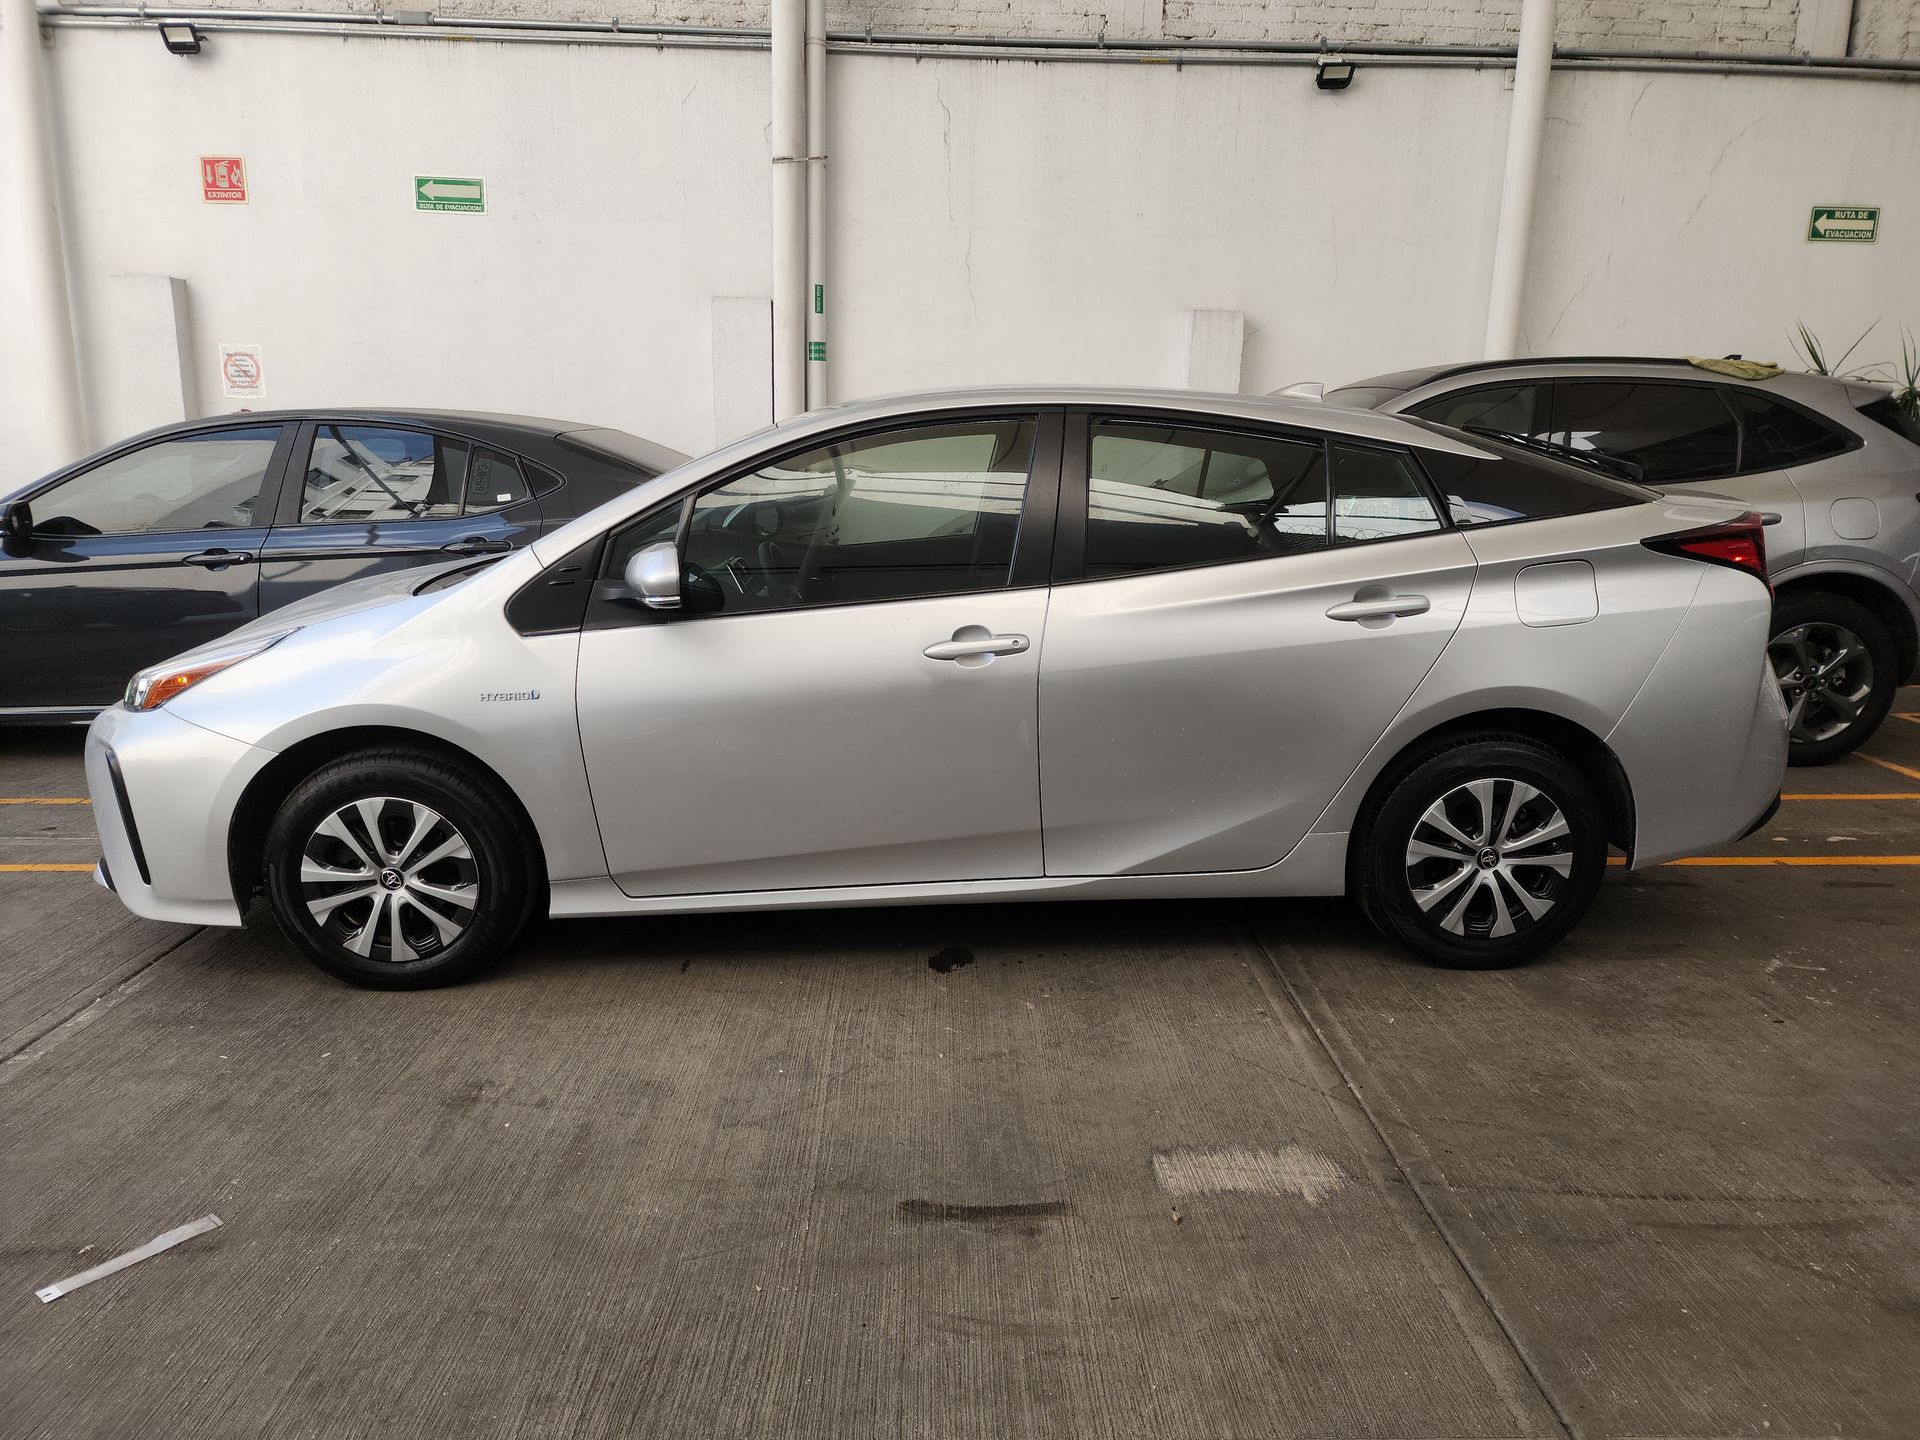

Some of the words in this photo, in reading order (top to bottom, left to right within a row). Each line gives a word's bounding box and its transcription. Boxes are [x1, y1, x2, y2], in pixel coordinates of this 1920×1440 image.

[1834, 211, 1857, 219] RUTA
[1858, 211, 1869, 219] DE
[1825, 230, 1872, 238] EVACUACION
[480, 692, 531, 701] HYBRID
